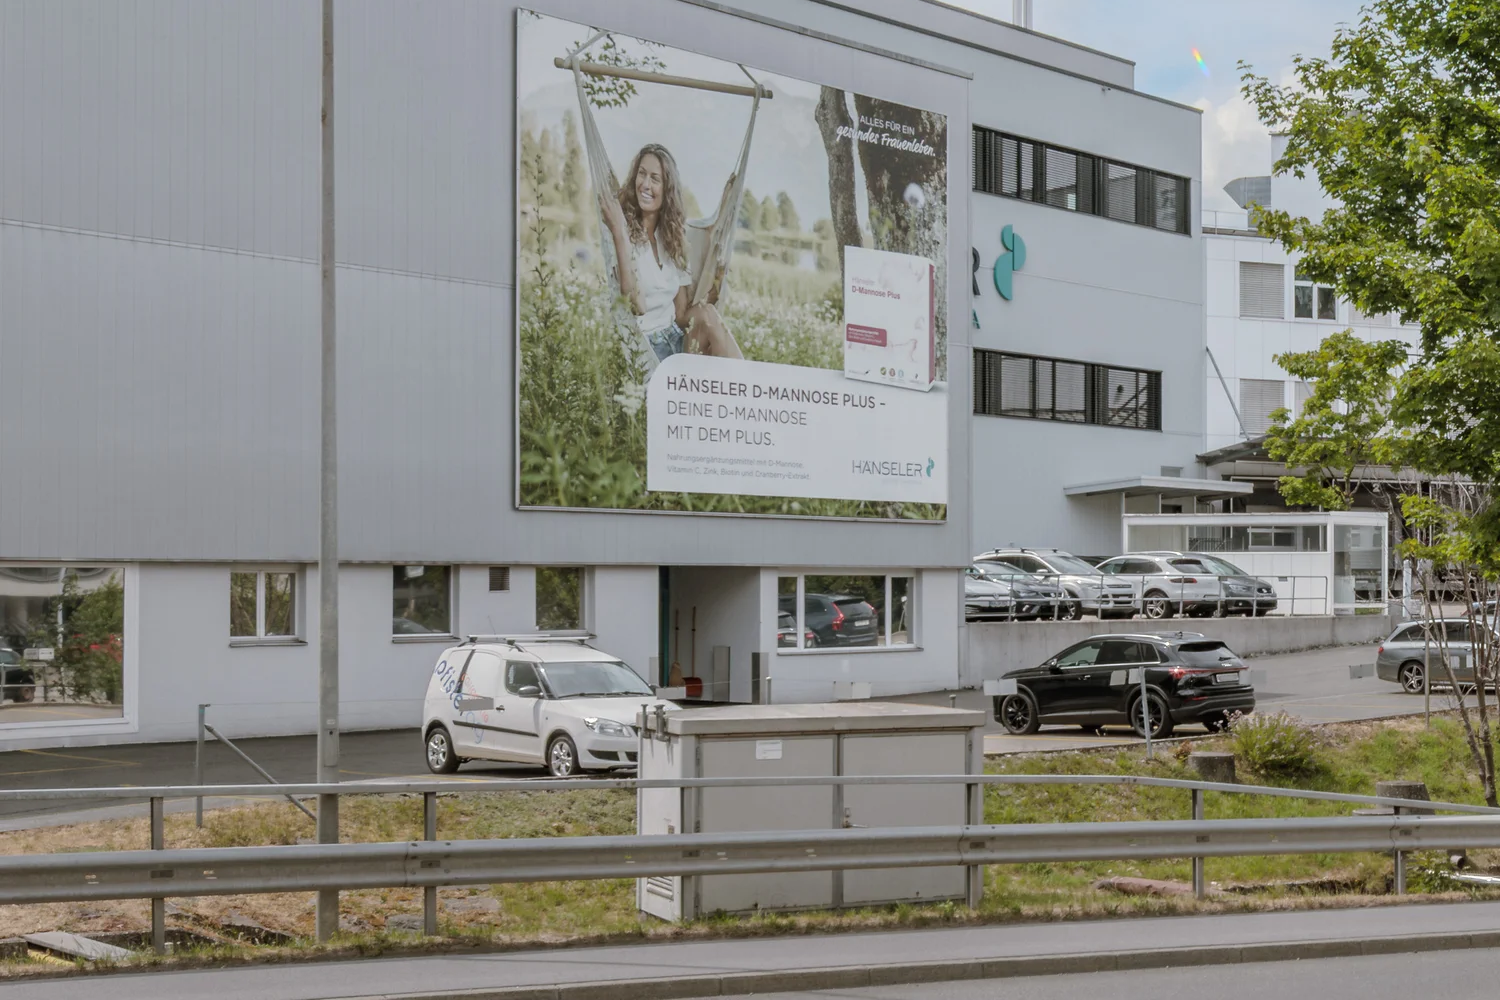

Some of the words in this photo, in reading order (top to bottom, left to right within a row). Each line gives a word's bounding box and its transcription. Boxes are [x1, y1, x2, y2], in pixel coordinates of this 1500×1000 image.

[860, 115, 884, 128] ALLES
[886, 120, 901, 132] FÜR
[902, 124, 915, 136] EIN
[836, 125, 880, 144] gesundes
[881, 133, 936, 157] Frauenleben.
[852, 286, 886, 298] D-Mannose
[887, 290, 901, 300] Plus
[667, 374, 748, 397] HÄNSELER
[752, 384, 838, 406] D-MANNOSE
[843, 394, 876, 408] PLUS
[667, 400, 713, 418] DEINE
[718, 404, 808, 426] D-MANNOSE
[667, 425, 693, 441] MIT
[698, 426, 731, 443] DEM
[736, 430, 776, 446] PLUS.
[852, 459, 923, 478] HÄNSELER
[1372, 483, 1380, 492] 2
[1468, 486, 1476, 495] 3
[434, 660, 464, 716] pfiste
